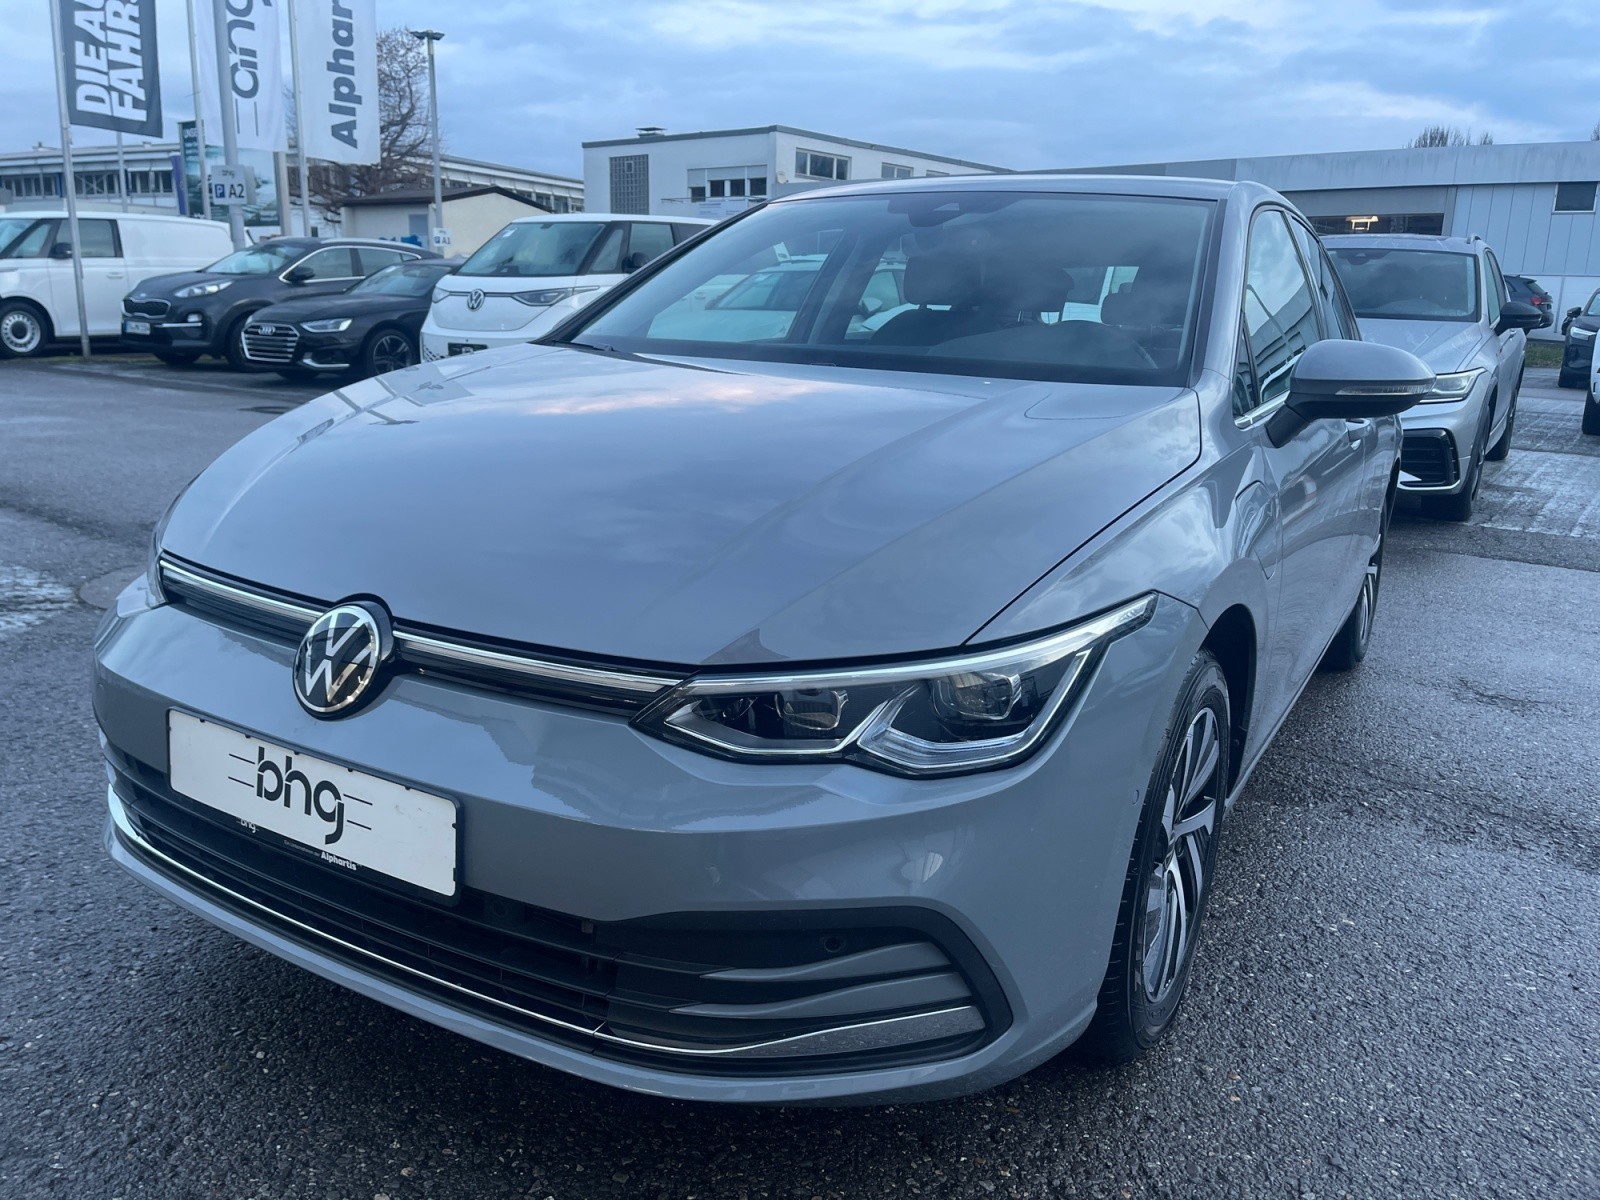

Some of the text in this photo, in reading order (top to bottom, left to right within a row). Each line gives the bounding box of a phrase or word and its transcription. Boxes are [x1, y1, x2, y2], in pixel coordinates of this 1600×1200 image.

[74, 0, 112, 116] DIE A
[105, 0, 147, 122] FAHR
[326, 0, 362, 149] Alphar
[228, 183, 245, 198] A2
[256, 746, 345, 845] bhg
[320, 851, 357, 871] Alphartis
